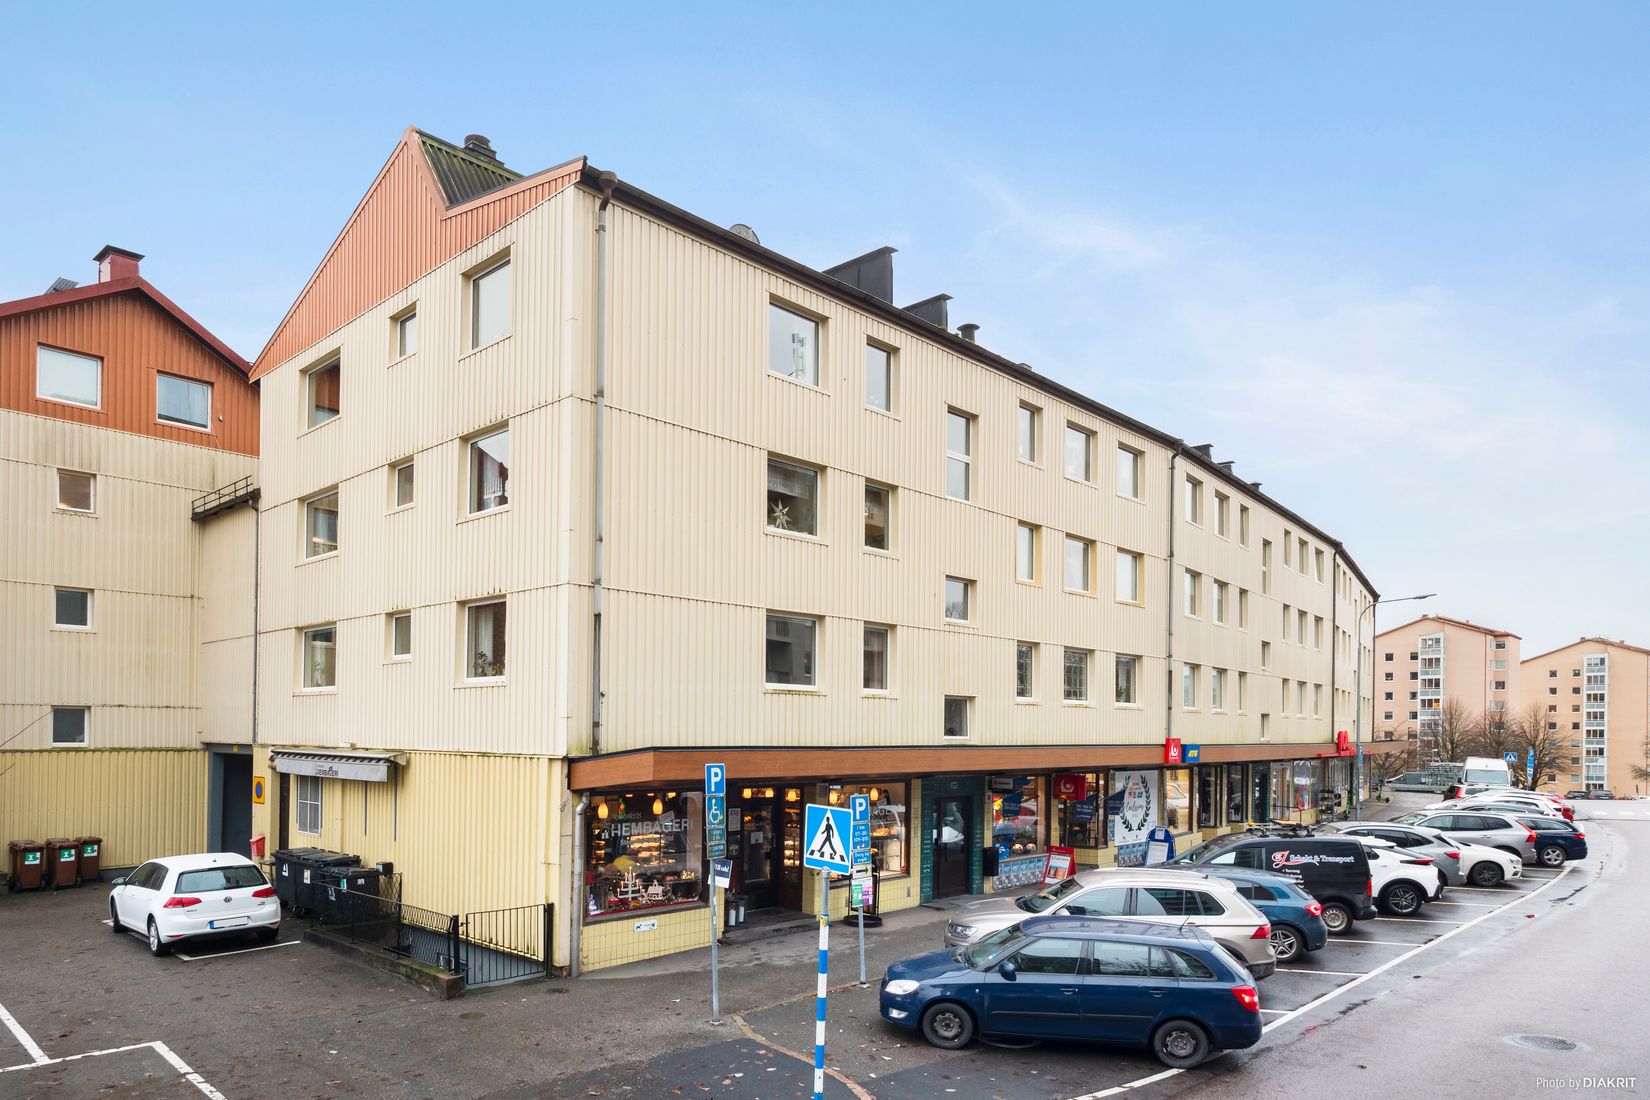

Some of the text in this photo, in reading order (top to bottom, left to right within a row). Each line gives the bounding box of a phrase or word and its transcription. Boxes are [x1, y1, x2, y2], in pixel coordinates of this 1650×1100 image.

[711, 767, 722, 791] P
[855, 798, 866, 820] P
[611, 818, 694, 837] HEMBAGERI
[1320, 855, 1355, 863] Transport
